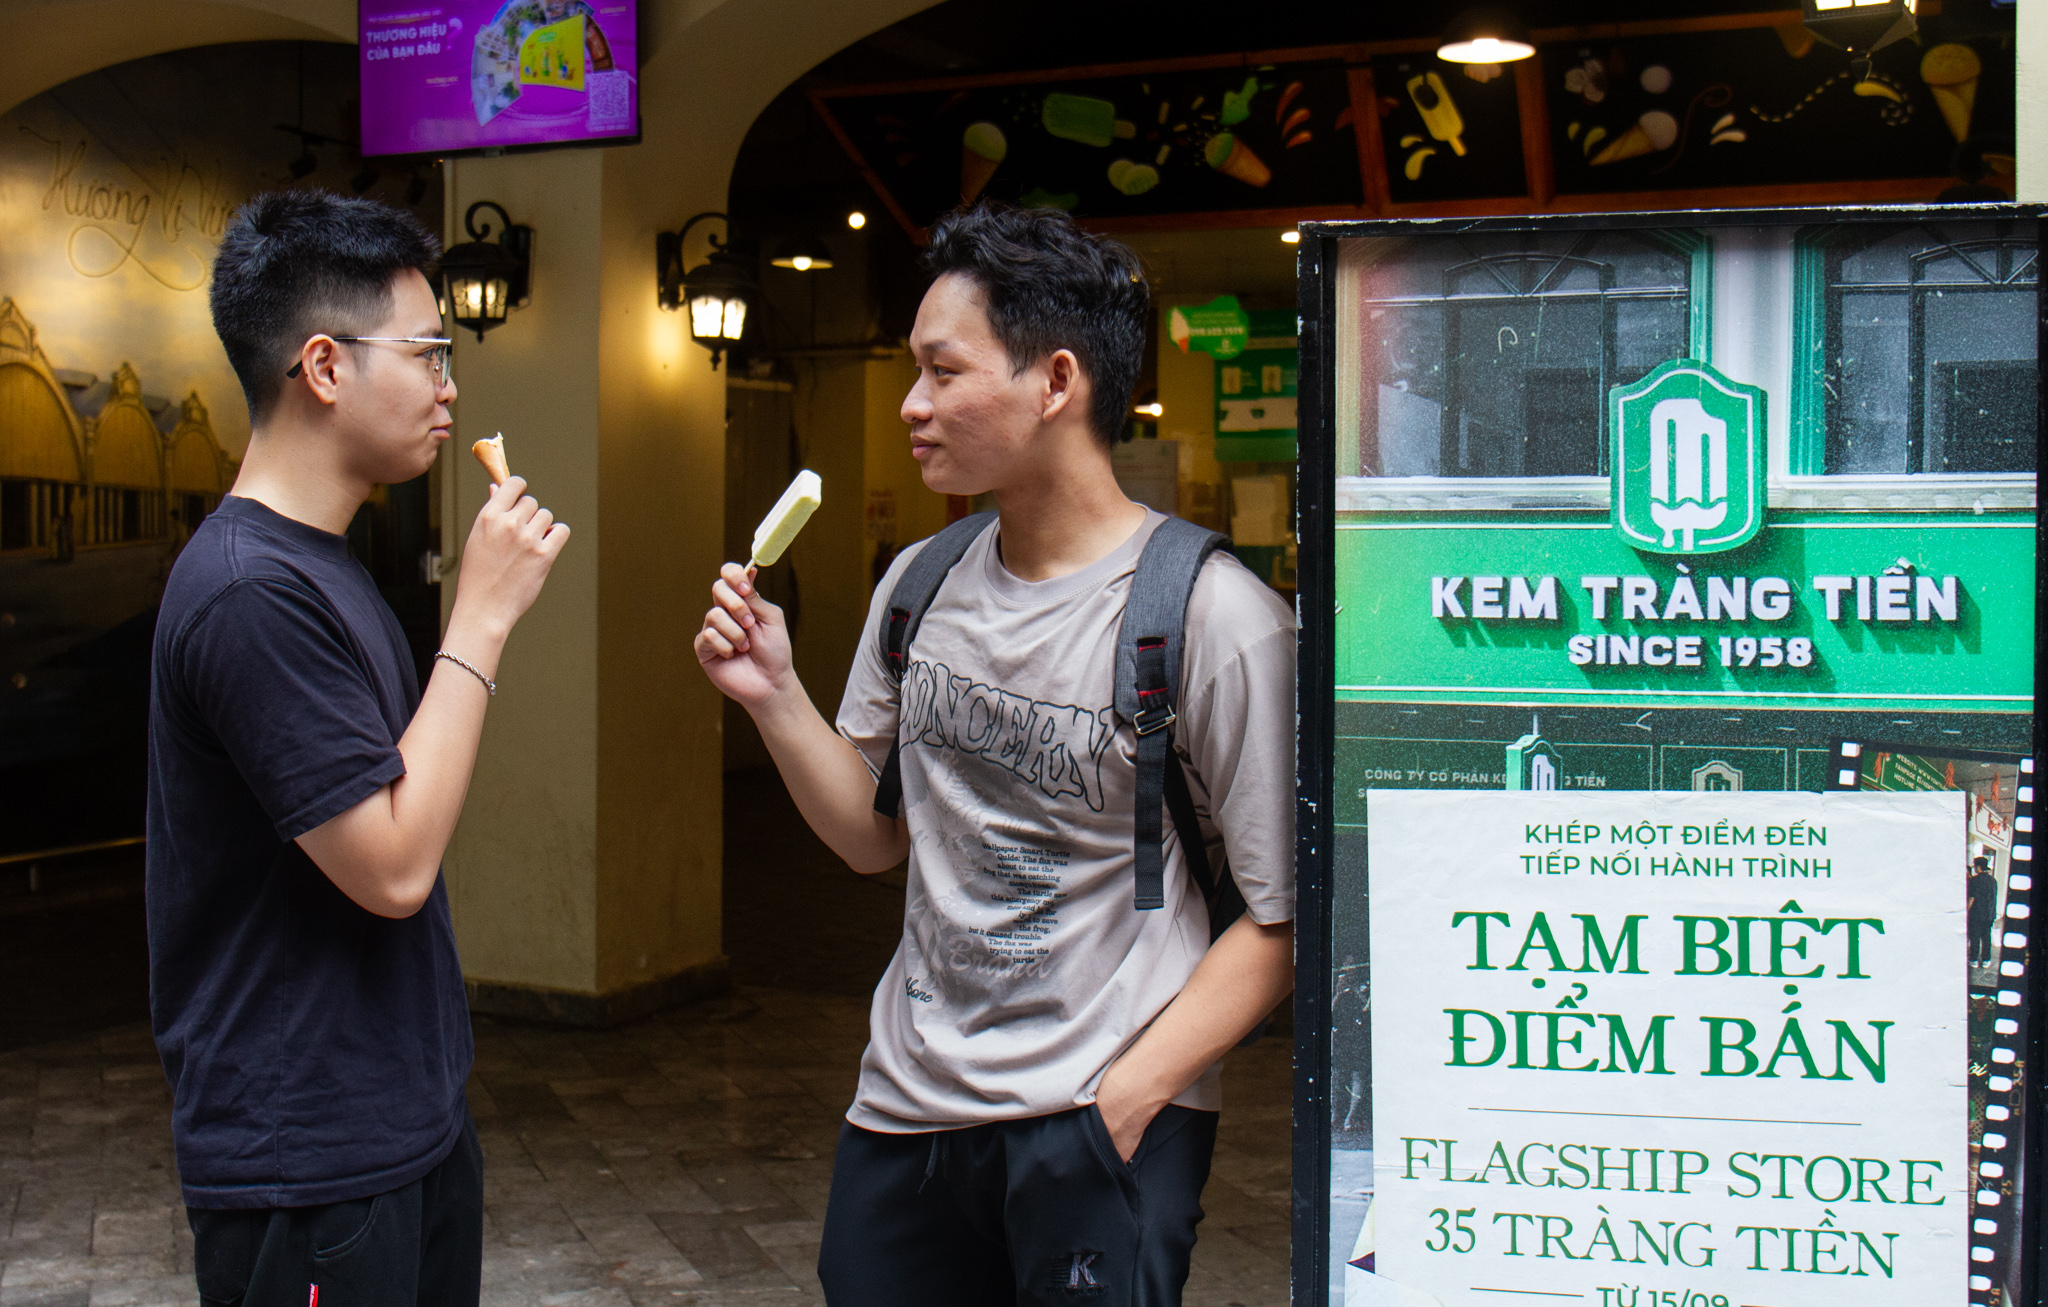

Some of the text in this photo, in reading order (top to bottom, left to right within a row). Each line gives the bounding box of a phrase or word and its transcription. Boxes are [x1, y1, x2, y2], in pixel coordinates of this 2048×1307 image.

[366, 22, 447, 43] THƯƠNG HIỆU
[367, 46, 389, 61] CỦA
[392, 45, 415, 60] BẠN
[1431, 557, 1957, 621] KEM TRÀNG TIỀN
[1568, 634, 1812, 668] SINCE 1958
[1365, 767, 1402, 781] CÔNG
[1407, 770, 1425, 781] TY
[1525, 818, 1828, 847] KHÉP MỘT ĐIỂM ĐẾN
[1020, 846, 1043, 855] Smart
[997, 862, 1017, 870] about
[1023, 856, 1037, 864] The
[1039, 857, 1051, 865] fox
[1519, 847, 1832, 879] TIẾP NỐI HÀNH TRÌNH
[997, 869, 1011, 878] that
[1028, 873, 1061, 883] catching
[991, 893, 1004, 902] this
[1017, 887, 1031, 896] The
[1033, 889, 1052, 898] turtle
[968, 926, 979, 935] but
[986, 930, 1012, 939] caused
[1019, 924, 1031, 932] the
[988, 938, 1002, 946] The
[1452, 900, 1885, 996] TẠM BIỆT
[989, 947, 1013, 956] trying
[1012, 956, 1035, 964] turtle
[1443, 983, 1896, 1084] ĐIỂM BÁN
[1400, 1137, 1946, 1206] FLAGSHIP STORE
[1425, 1205, 1900, 1279] 35 TRÀNG TIỀN
[1066, 1251, 1101, 1288] K
[1596, 1283, 1640, 1307] TỪ
